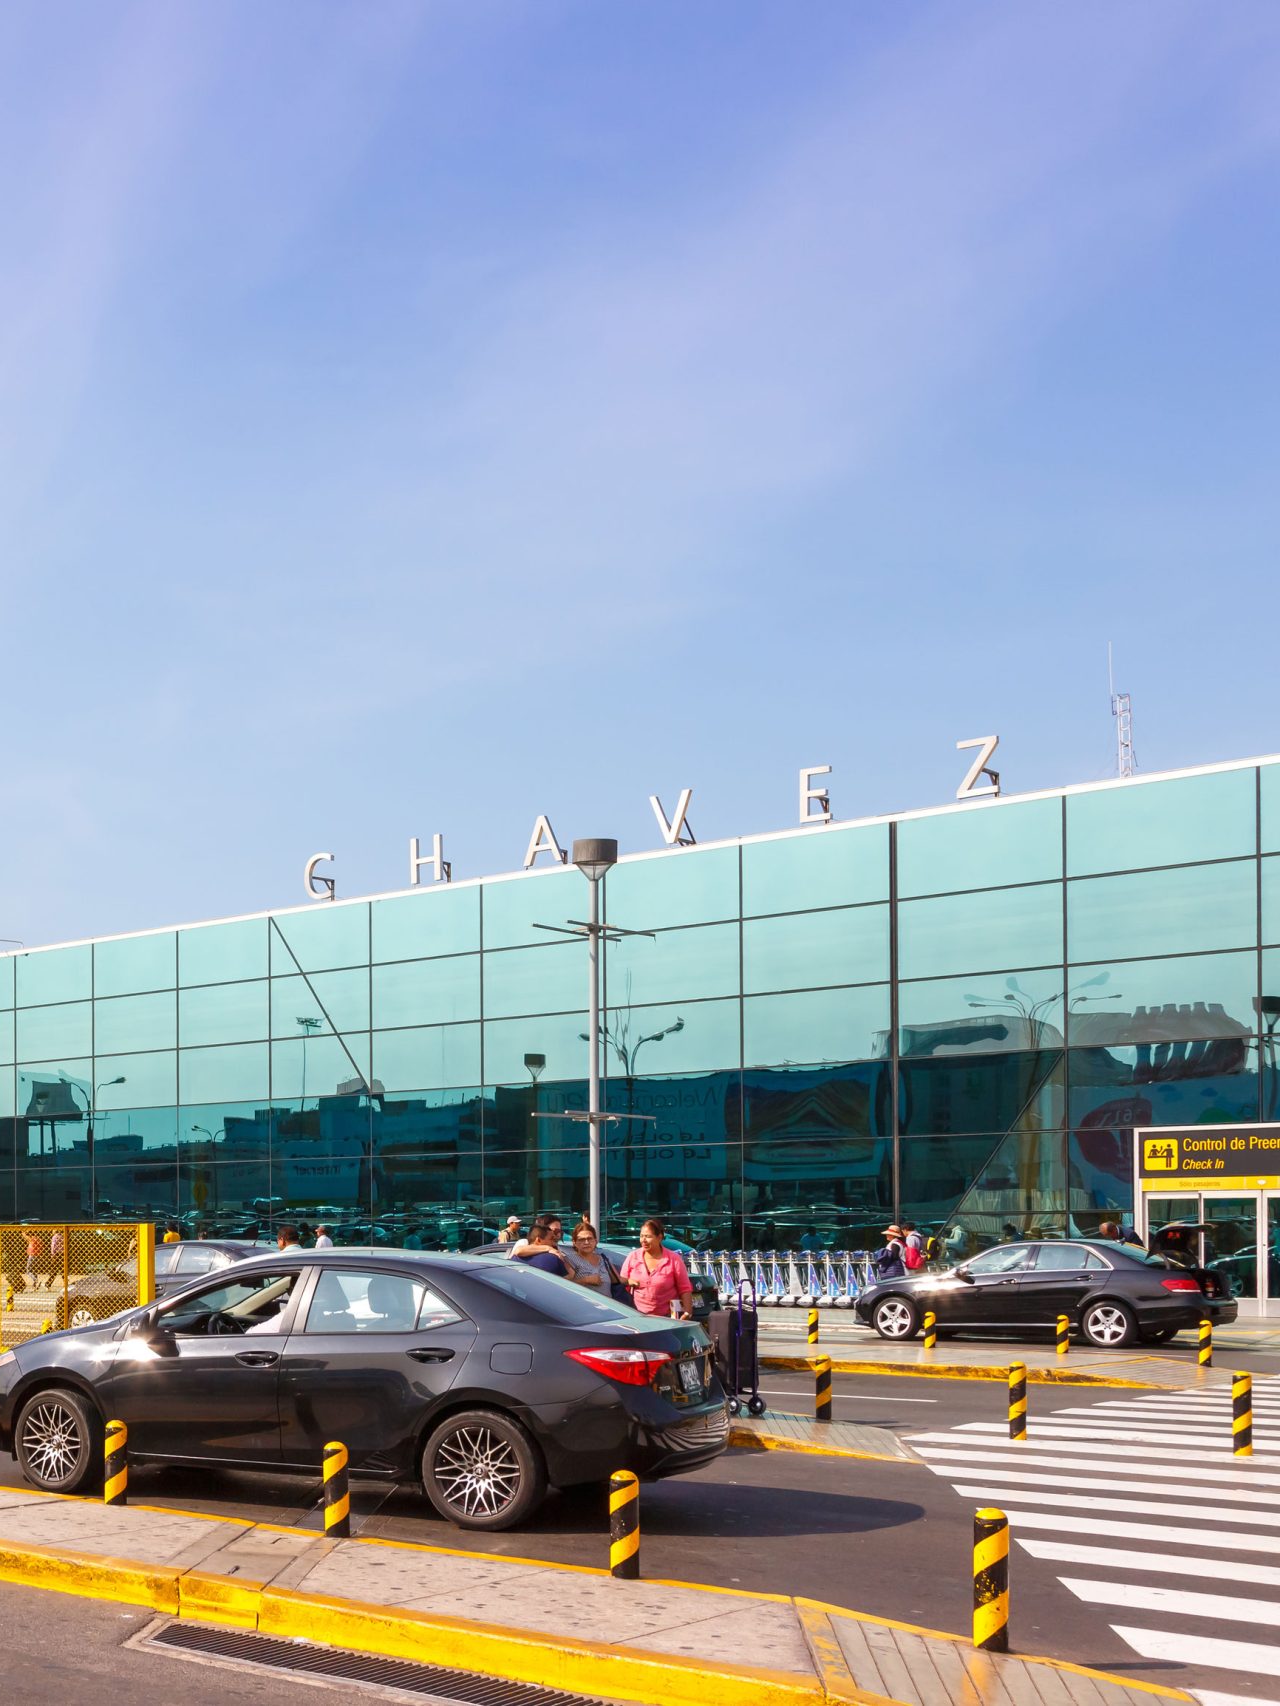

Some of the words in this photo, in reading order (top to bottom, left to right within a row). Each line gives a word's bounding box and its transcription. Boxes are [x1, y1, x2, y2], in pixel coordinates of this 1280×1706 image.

[304, 735, 999, 901] CHAVEZ
[1182, 1137, 1226, 1152] Control
[1230, 1136, 1246, 1150] de
[1182, 1158, 1212, 1170] Check
[1214, 1158, 1225, 1169] In
